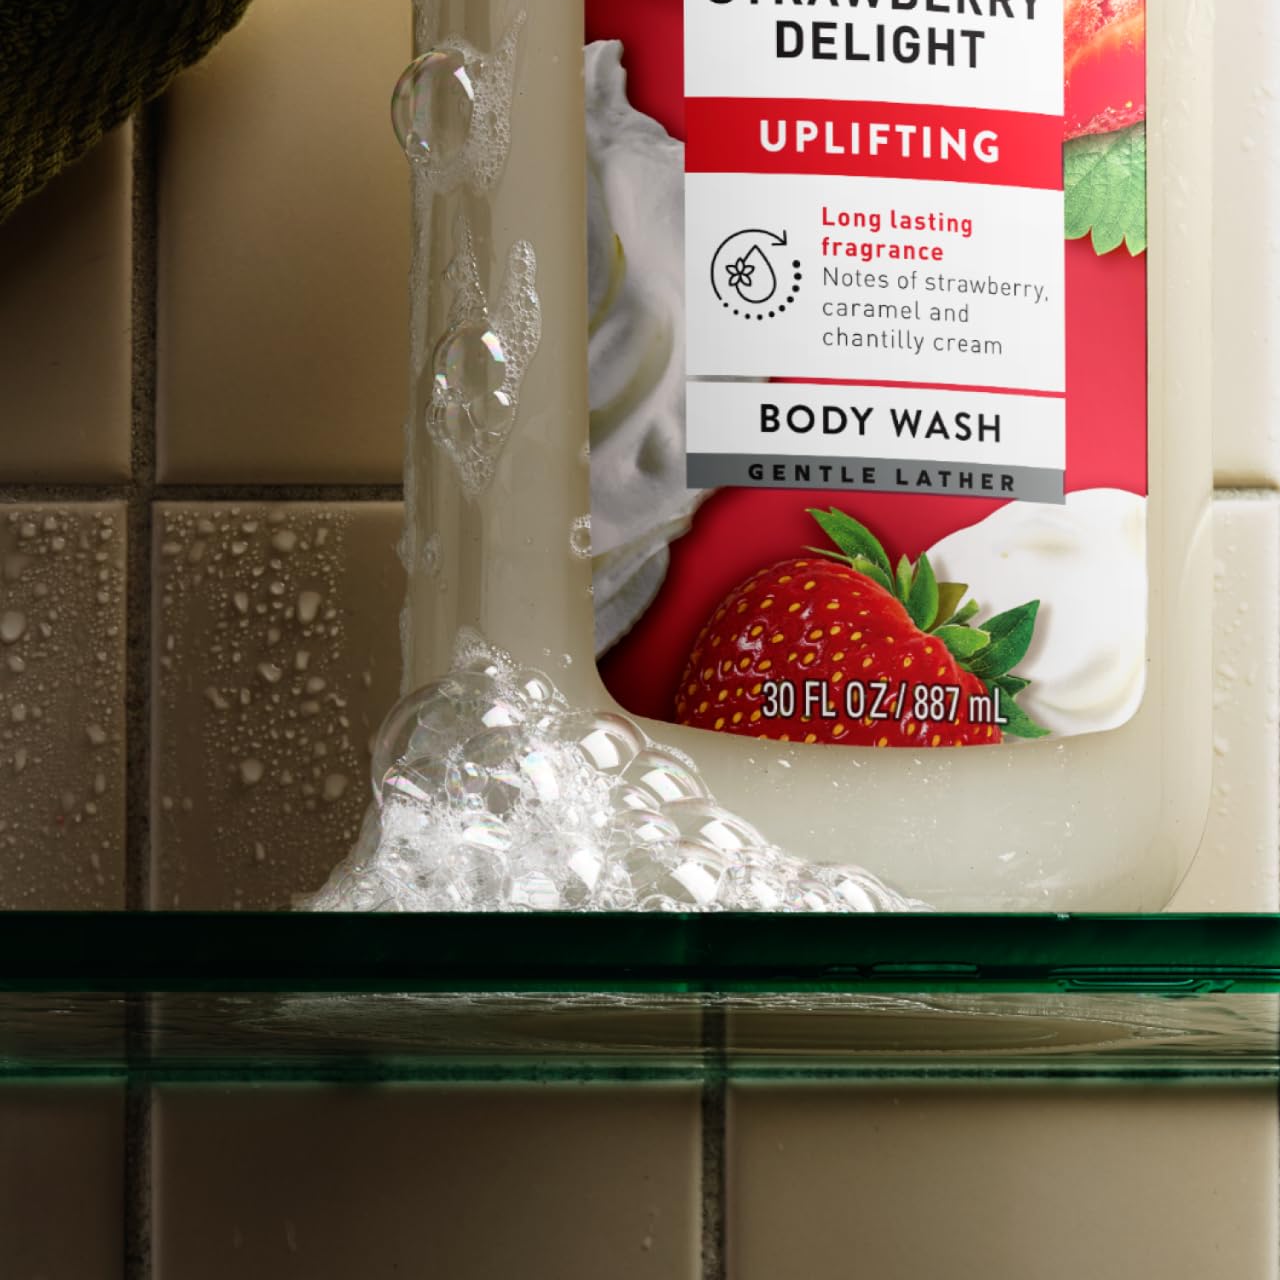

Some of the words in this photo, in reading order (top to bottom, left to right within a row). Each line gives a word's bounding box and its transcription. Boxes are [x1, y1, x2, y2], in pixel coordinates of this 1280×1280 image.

[775, 20, 985, 68] DELIGHT
[760, 119, 1000, 164] UPLIFTING
[822, 206, 881, 232] Long
[890, 208, 973, 238] lasting
[821, 237, 944, 263] fragrance
[822, 267, 889, 290] Notes
[896, 268, 918, 290] of
[925, 270, 1049, 303] strawberry,
[822, 298, 921, 321] caramel
[930, 302, 969, 323] and
[822, 328, 924, 355] chantilly
[933, 334, 1003, 354] cream
[760, 403, 874, 437] BODY
[890, 408, 1001, 443] WASH
[748, 463, 877, 485] GENTLE
[896, 468, 1015, 492] LATHER
